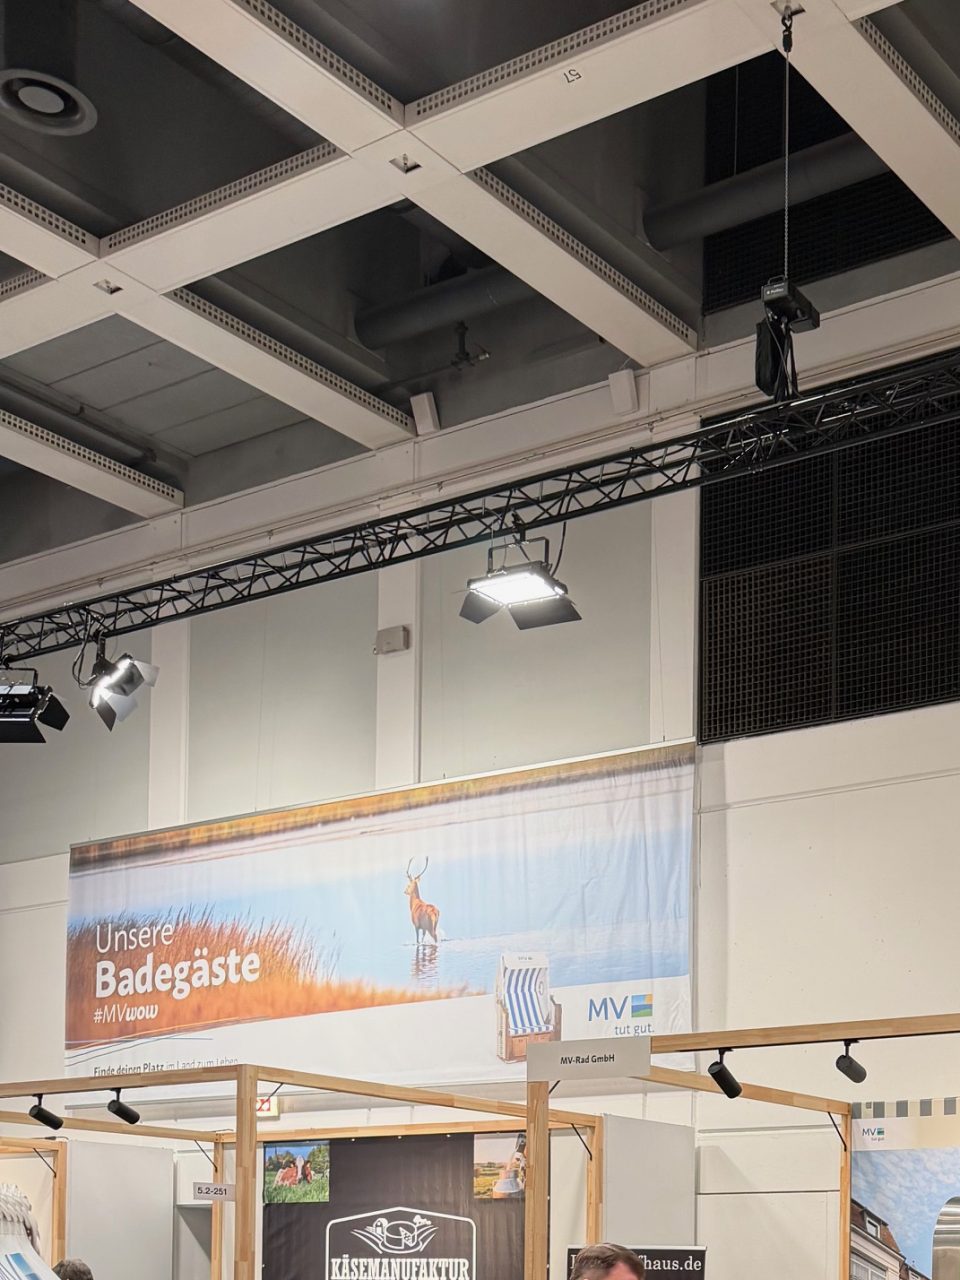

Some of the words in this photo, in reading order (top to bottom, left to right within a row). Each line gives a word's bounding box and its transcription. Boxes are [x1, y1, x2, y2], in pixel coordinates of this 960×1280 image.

[95, 922, 174, 954] Unsere
[95, 947, 261, 1000] Badegäste
[93, 1003, 159, 1025] #MVwow
[588, 995, 629, 1022] MV
[614, 1024, 631, 1036] tut
[633, 1023, 655, 1037] gut.
[560, 1055, 590, 1065] MV-Rad
[591, 1054, 615, 1064] GmbH
[93, 1066, 115, 1077] Finde
[143, 1062, 164, 1073] Platz
[862, 1127, 877, 1137] MV
[197, 1186, 227, 1196] 5.2-251
[330, 1254, 470, 1280] KÄSEMANUFAKTUR
